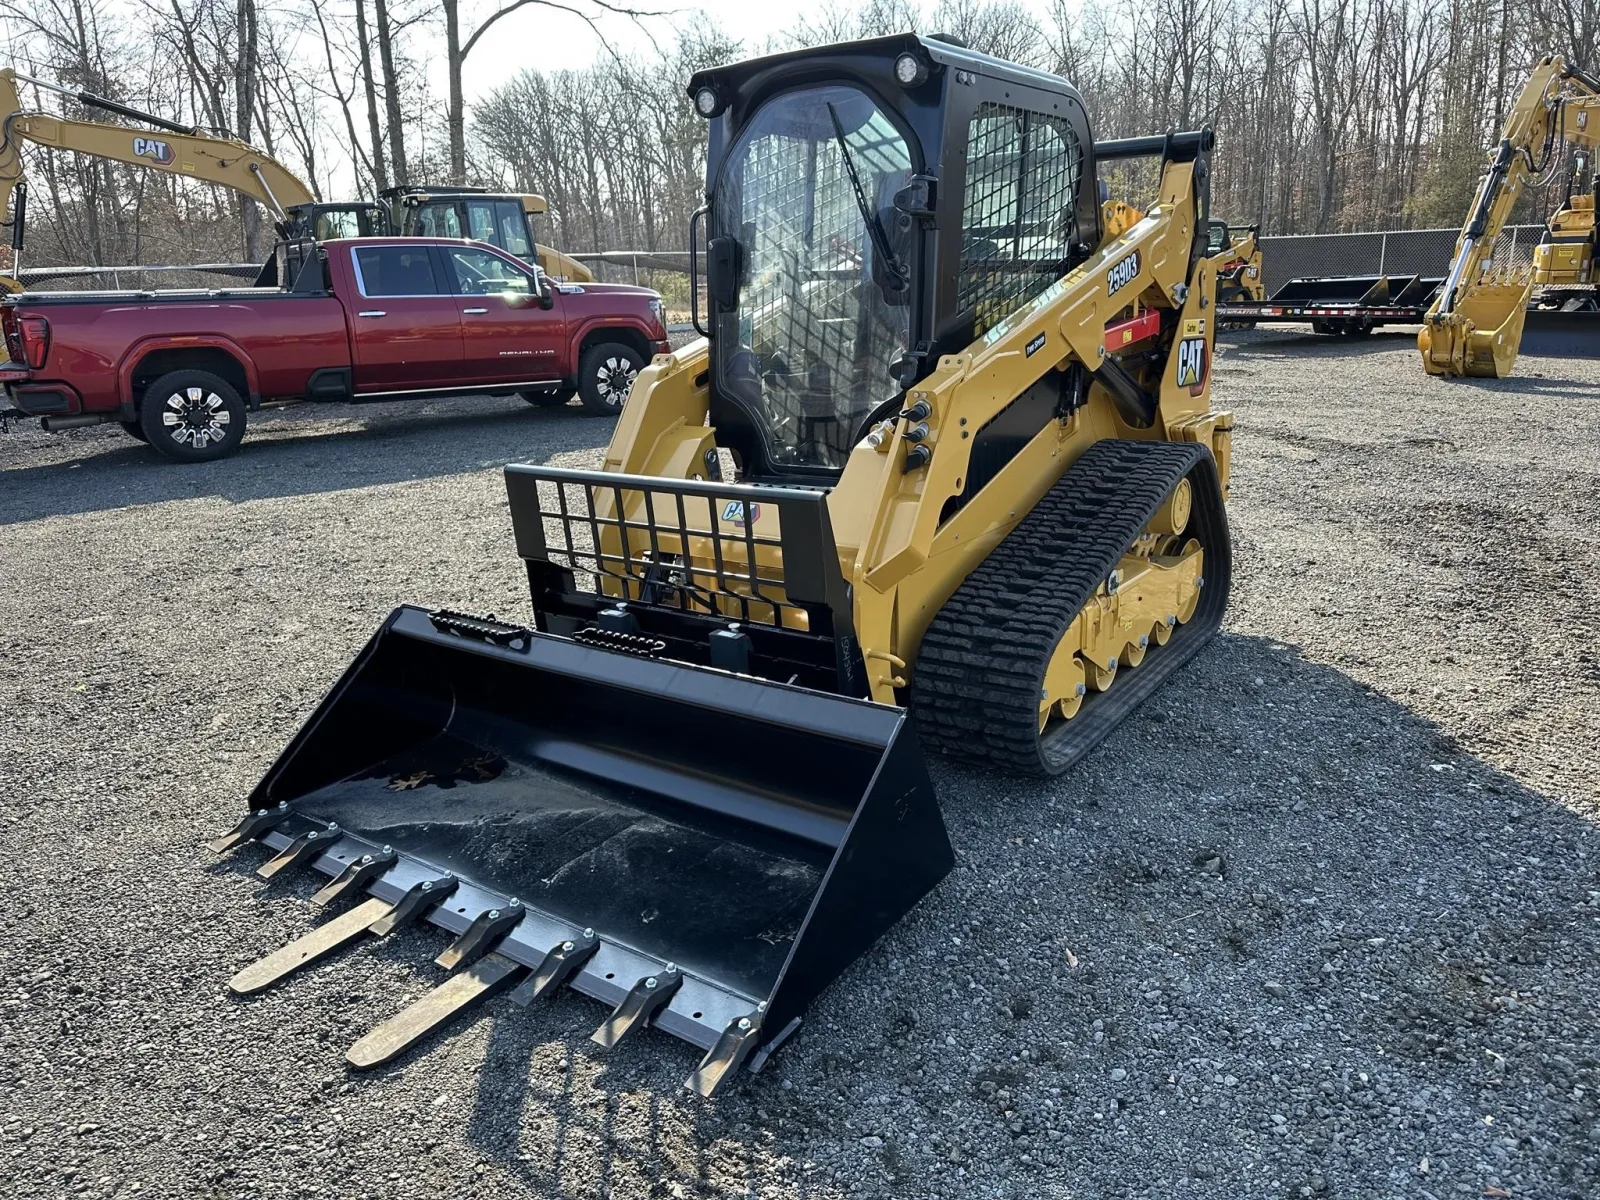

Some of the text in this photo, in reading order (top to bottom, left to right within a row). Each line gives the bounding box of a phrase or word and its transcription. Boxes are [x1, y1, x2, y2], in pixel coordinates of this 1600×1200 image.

[134, 137, 166, 160] CAT
[1107, 252, 1138, 297] 259D3
[1178, 340, 1204, 386] CAT
[722, 501, 757, 520] CA
